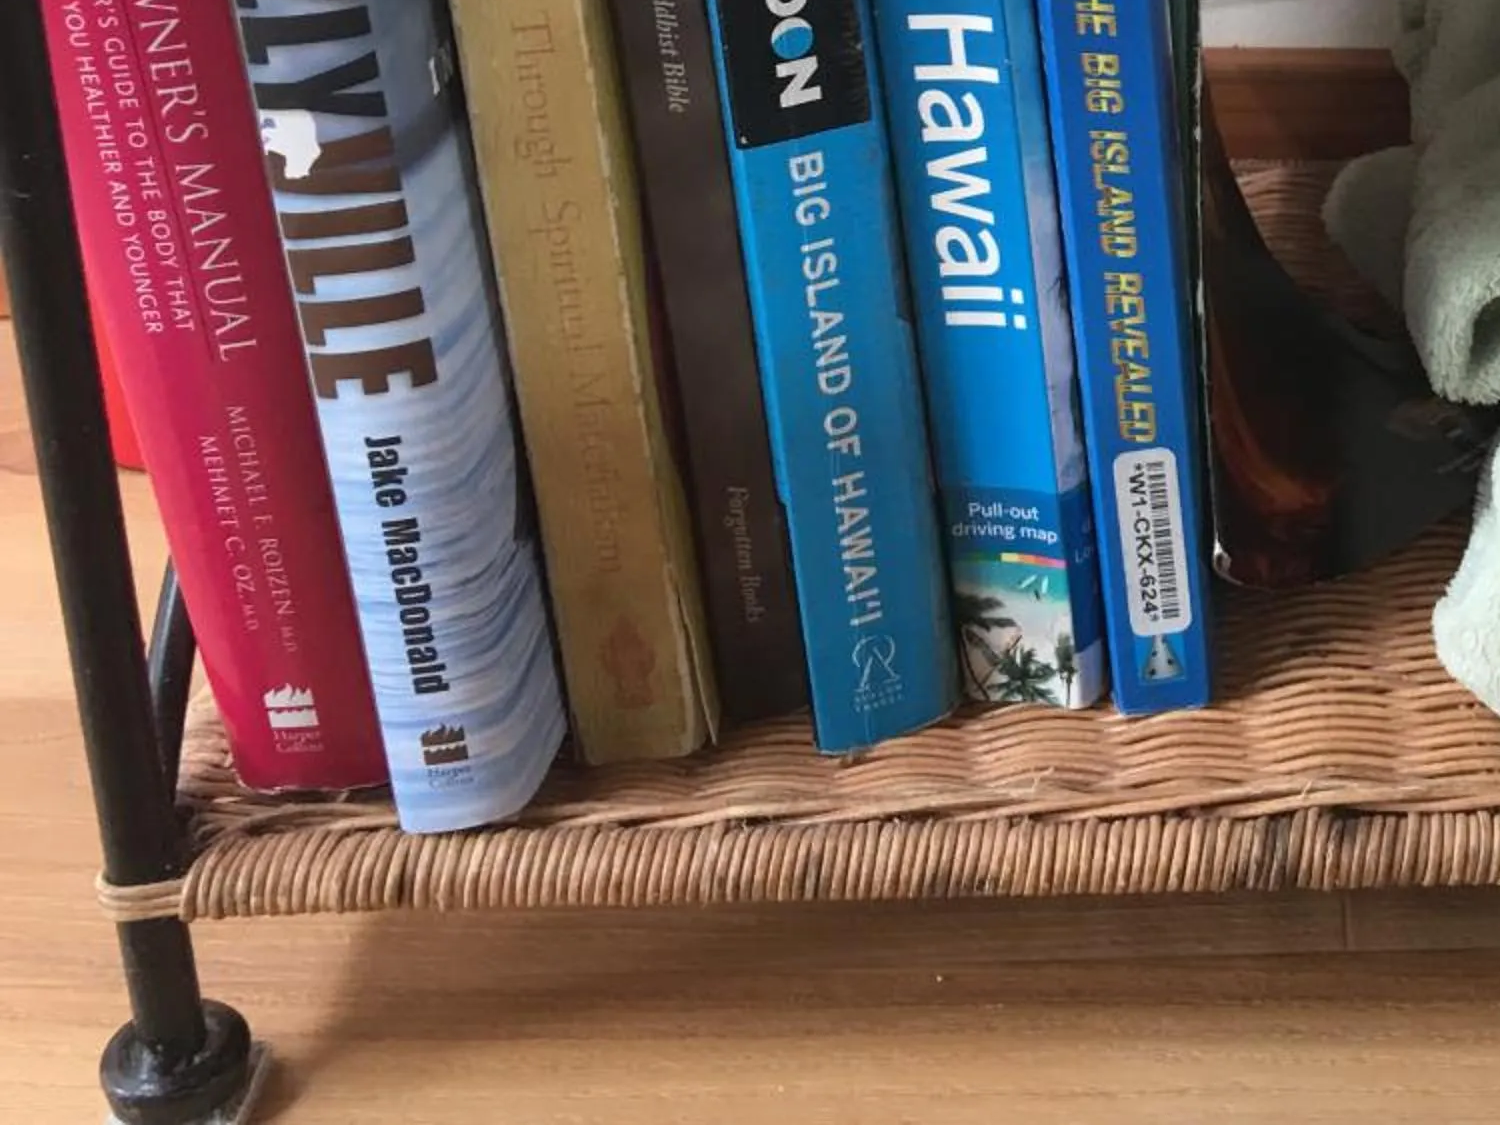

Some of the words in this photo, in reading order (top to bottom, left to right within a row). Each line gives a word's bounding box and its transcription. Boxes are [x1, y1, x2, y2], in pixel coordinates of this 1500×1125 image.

[60, 1, 90, 47] YOU
[105, 38, 139, 109] GUIDE
[511, 10, 573, 179] Through
[663, 63, 691, 114] Bible
[1080, 52, 1124, 115] BIG
[75, 56, 123, 174] HEALTHIER
[126, 118, 148, 148] TO
[109, 181, 136, 227] AND
[135, 156, 163, 200] THE
[789, 151, 831, 226] BIG
[907, 14, 1027, 329] Hawaii
[1089, 130, 1138, 258] ISLAND
[148, 210, 180, 269] BODY
[175, 163, 257, 363] MANUAL
[121, 234, 164, 334] YOUNGER
[167, 276, 195, 332] THAT
[800, 237, 851, 396] ISLAND
[1103, 272, 1157, 443] REVEALED
[226, 406, 268, 505] MICHAEL
[824, 406, 862, 457] OF
[199, 435, 240, 528] MEHMET
[364, 435, 408, 508] Jake
[952, 523, 1016, 540] driving
[1020, 527, 1058, 545] map
[968, 502, 1039, 522] Pull-out
[381, 517, 450, 695] MacDonald
